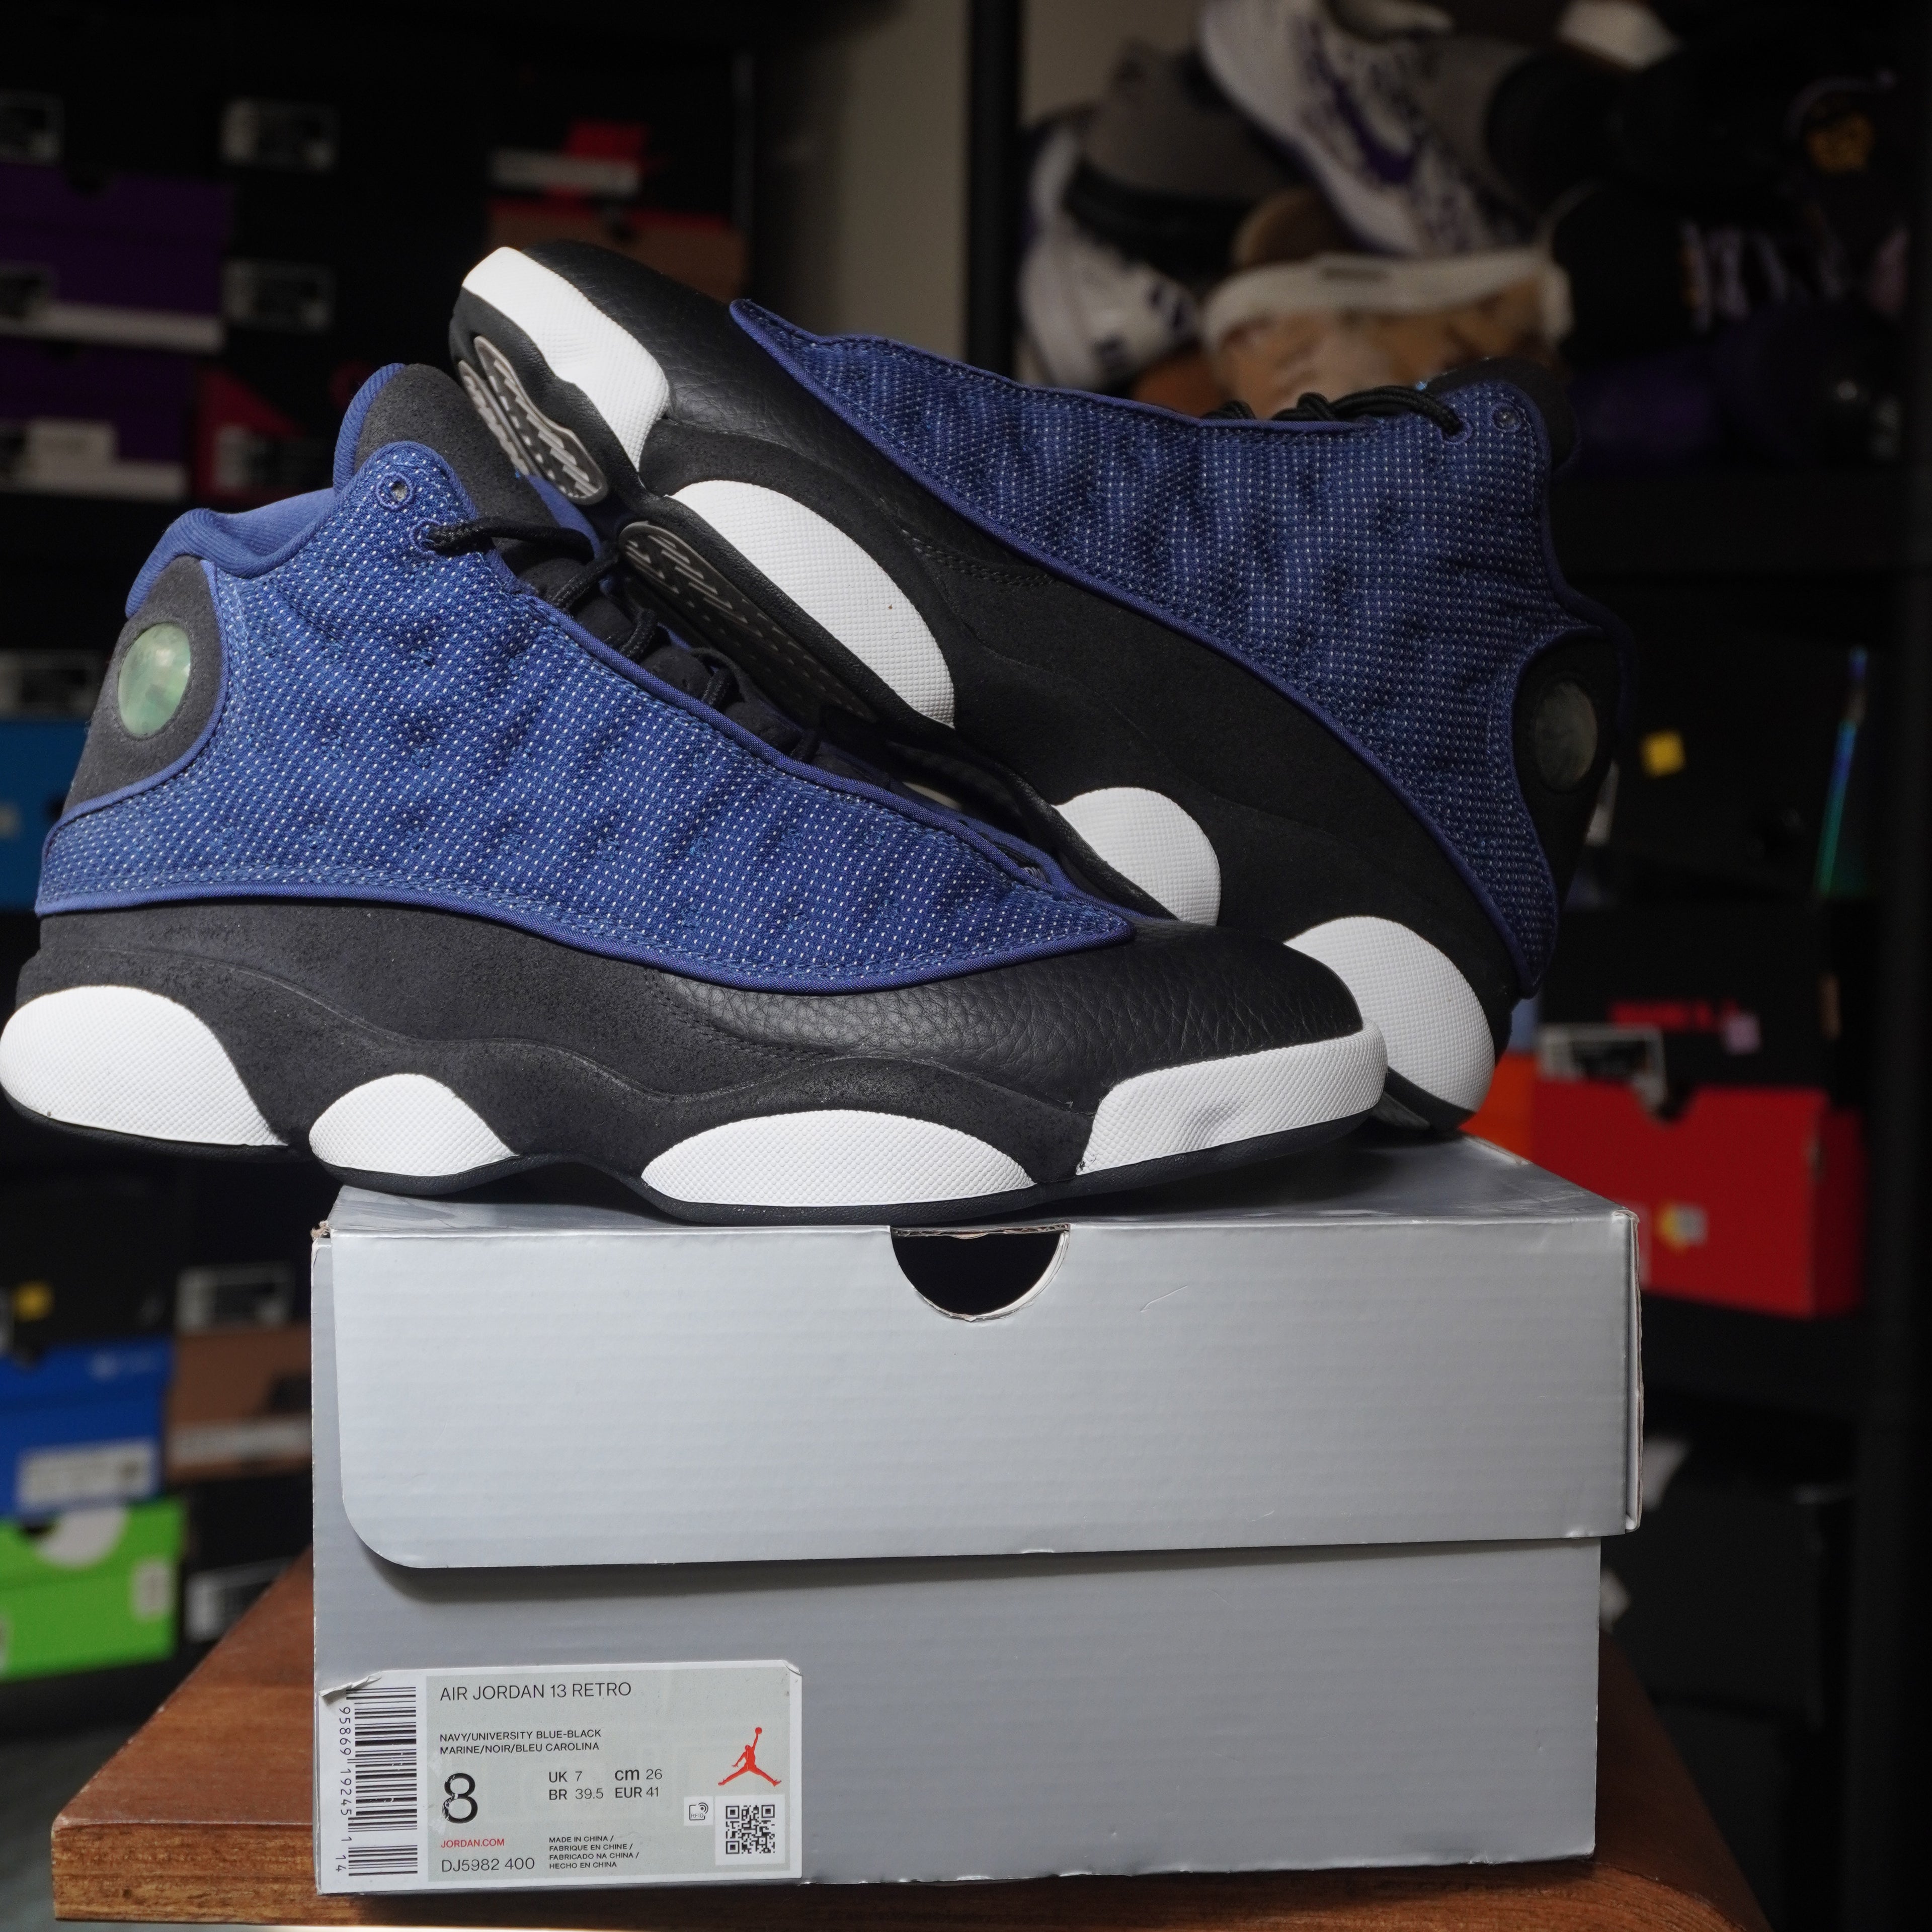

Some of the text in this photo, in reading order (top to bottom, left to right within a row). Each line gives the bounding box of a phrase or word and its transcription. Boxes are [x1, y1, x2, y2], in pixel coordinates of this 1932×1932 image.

[440, 1682, 631, 1701] AIR JORDAN 13 RETRO
[339, 1707, 351, 1755] 95869
[440, 1729, 601, 1742] NAVY/UNIVERSITY BLUE-BLACK
[440, 1742, 599, 1754] MARINE/NOIR/BLEU CAROLINA
[549, 1771, 582, 1783] UK 7
[614, 1769, 662, 1781] cm 26
[340, 1768, 352, 1815] 19245
[549, 1789, 604, 1800] BR 39.5
[615, 1787, 659, 1798] EUR 41
[442, 1773, 478, 1824] 8
[441, 1838, 505, 1848] JORDAN.COM
[336, 1855, 347, 1872] 14
[441, 1857, 535, 1874] DJ5982 400
